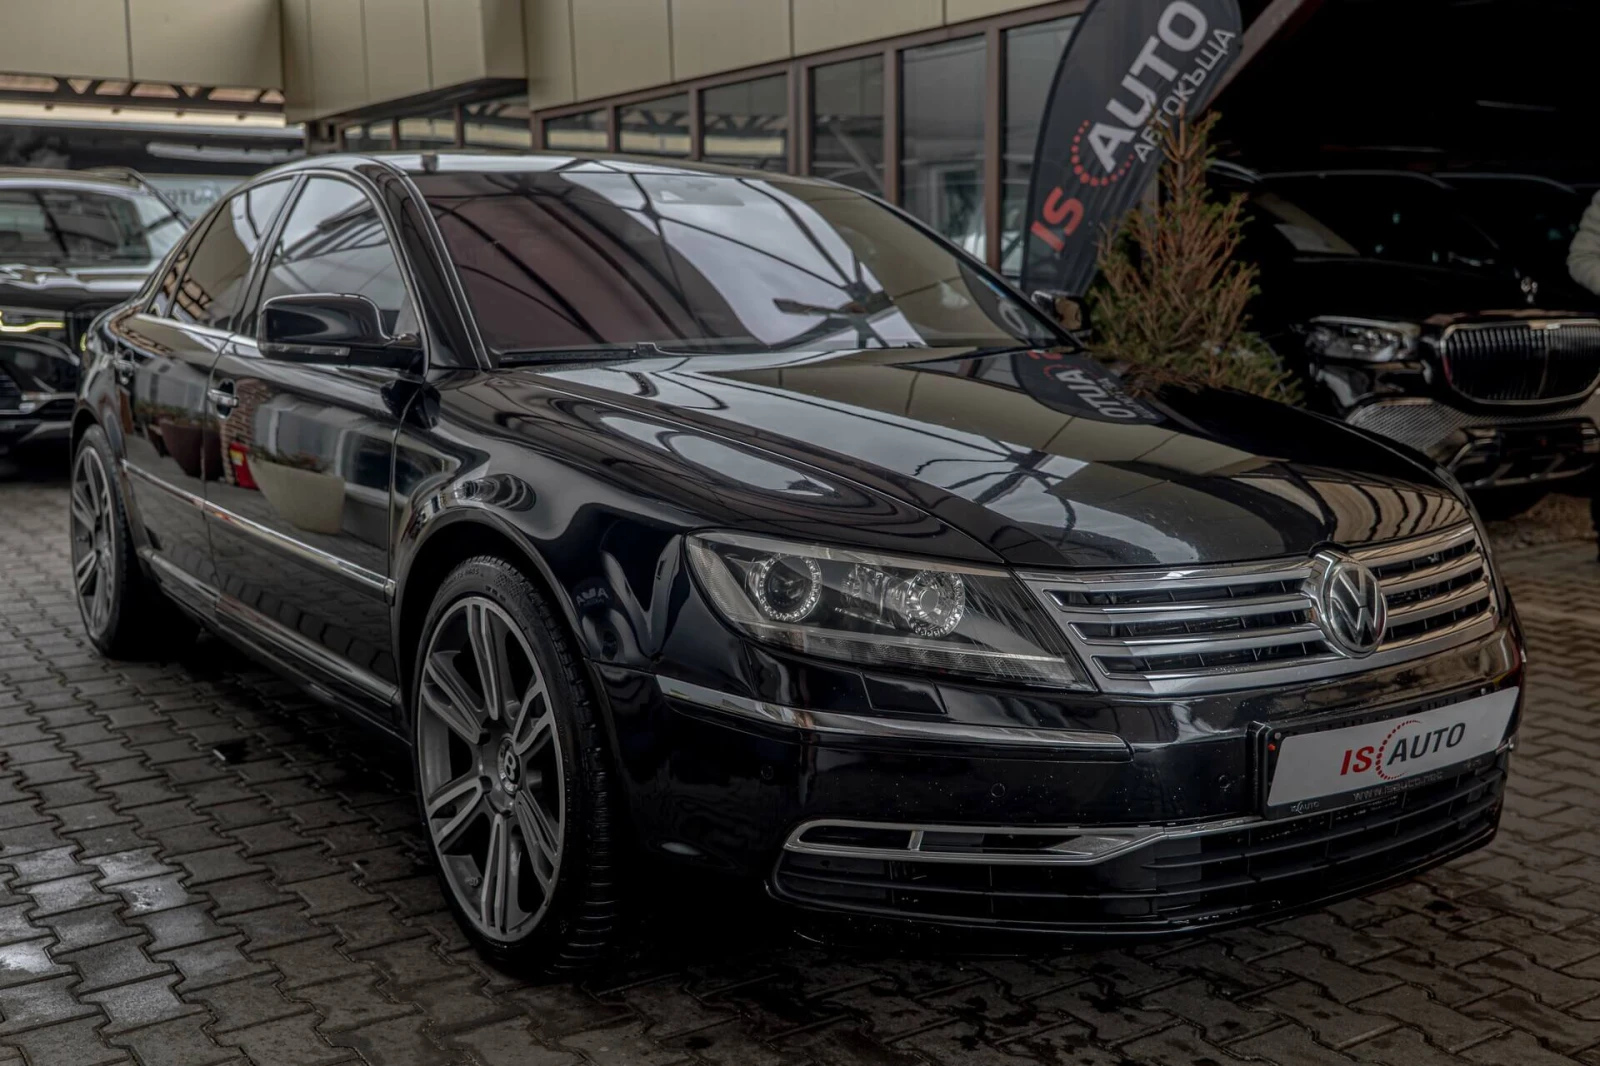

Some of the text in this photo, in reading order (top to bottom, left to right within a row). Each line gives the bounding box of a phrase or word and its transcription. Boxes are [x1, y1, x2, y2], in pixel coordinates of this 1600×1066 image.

[1030, 186, 1085, 251] IS
[1086, 0, 1209, 174] AUTO
[1339, 722, 1466, 776] IS AUTO
